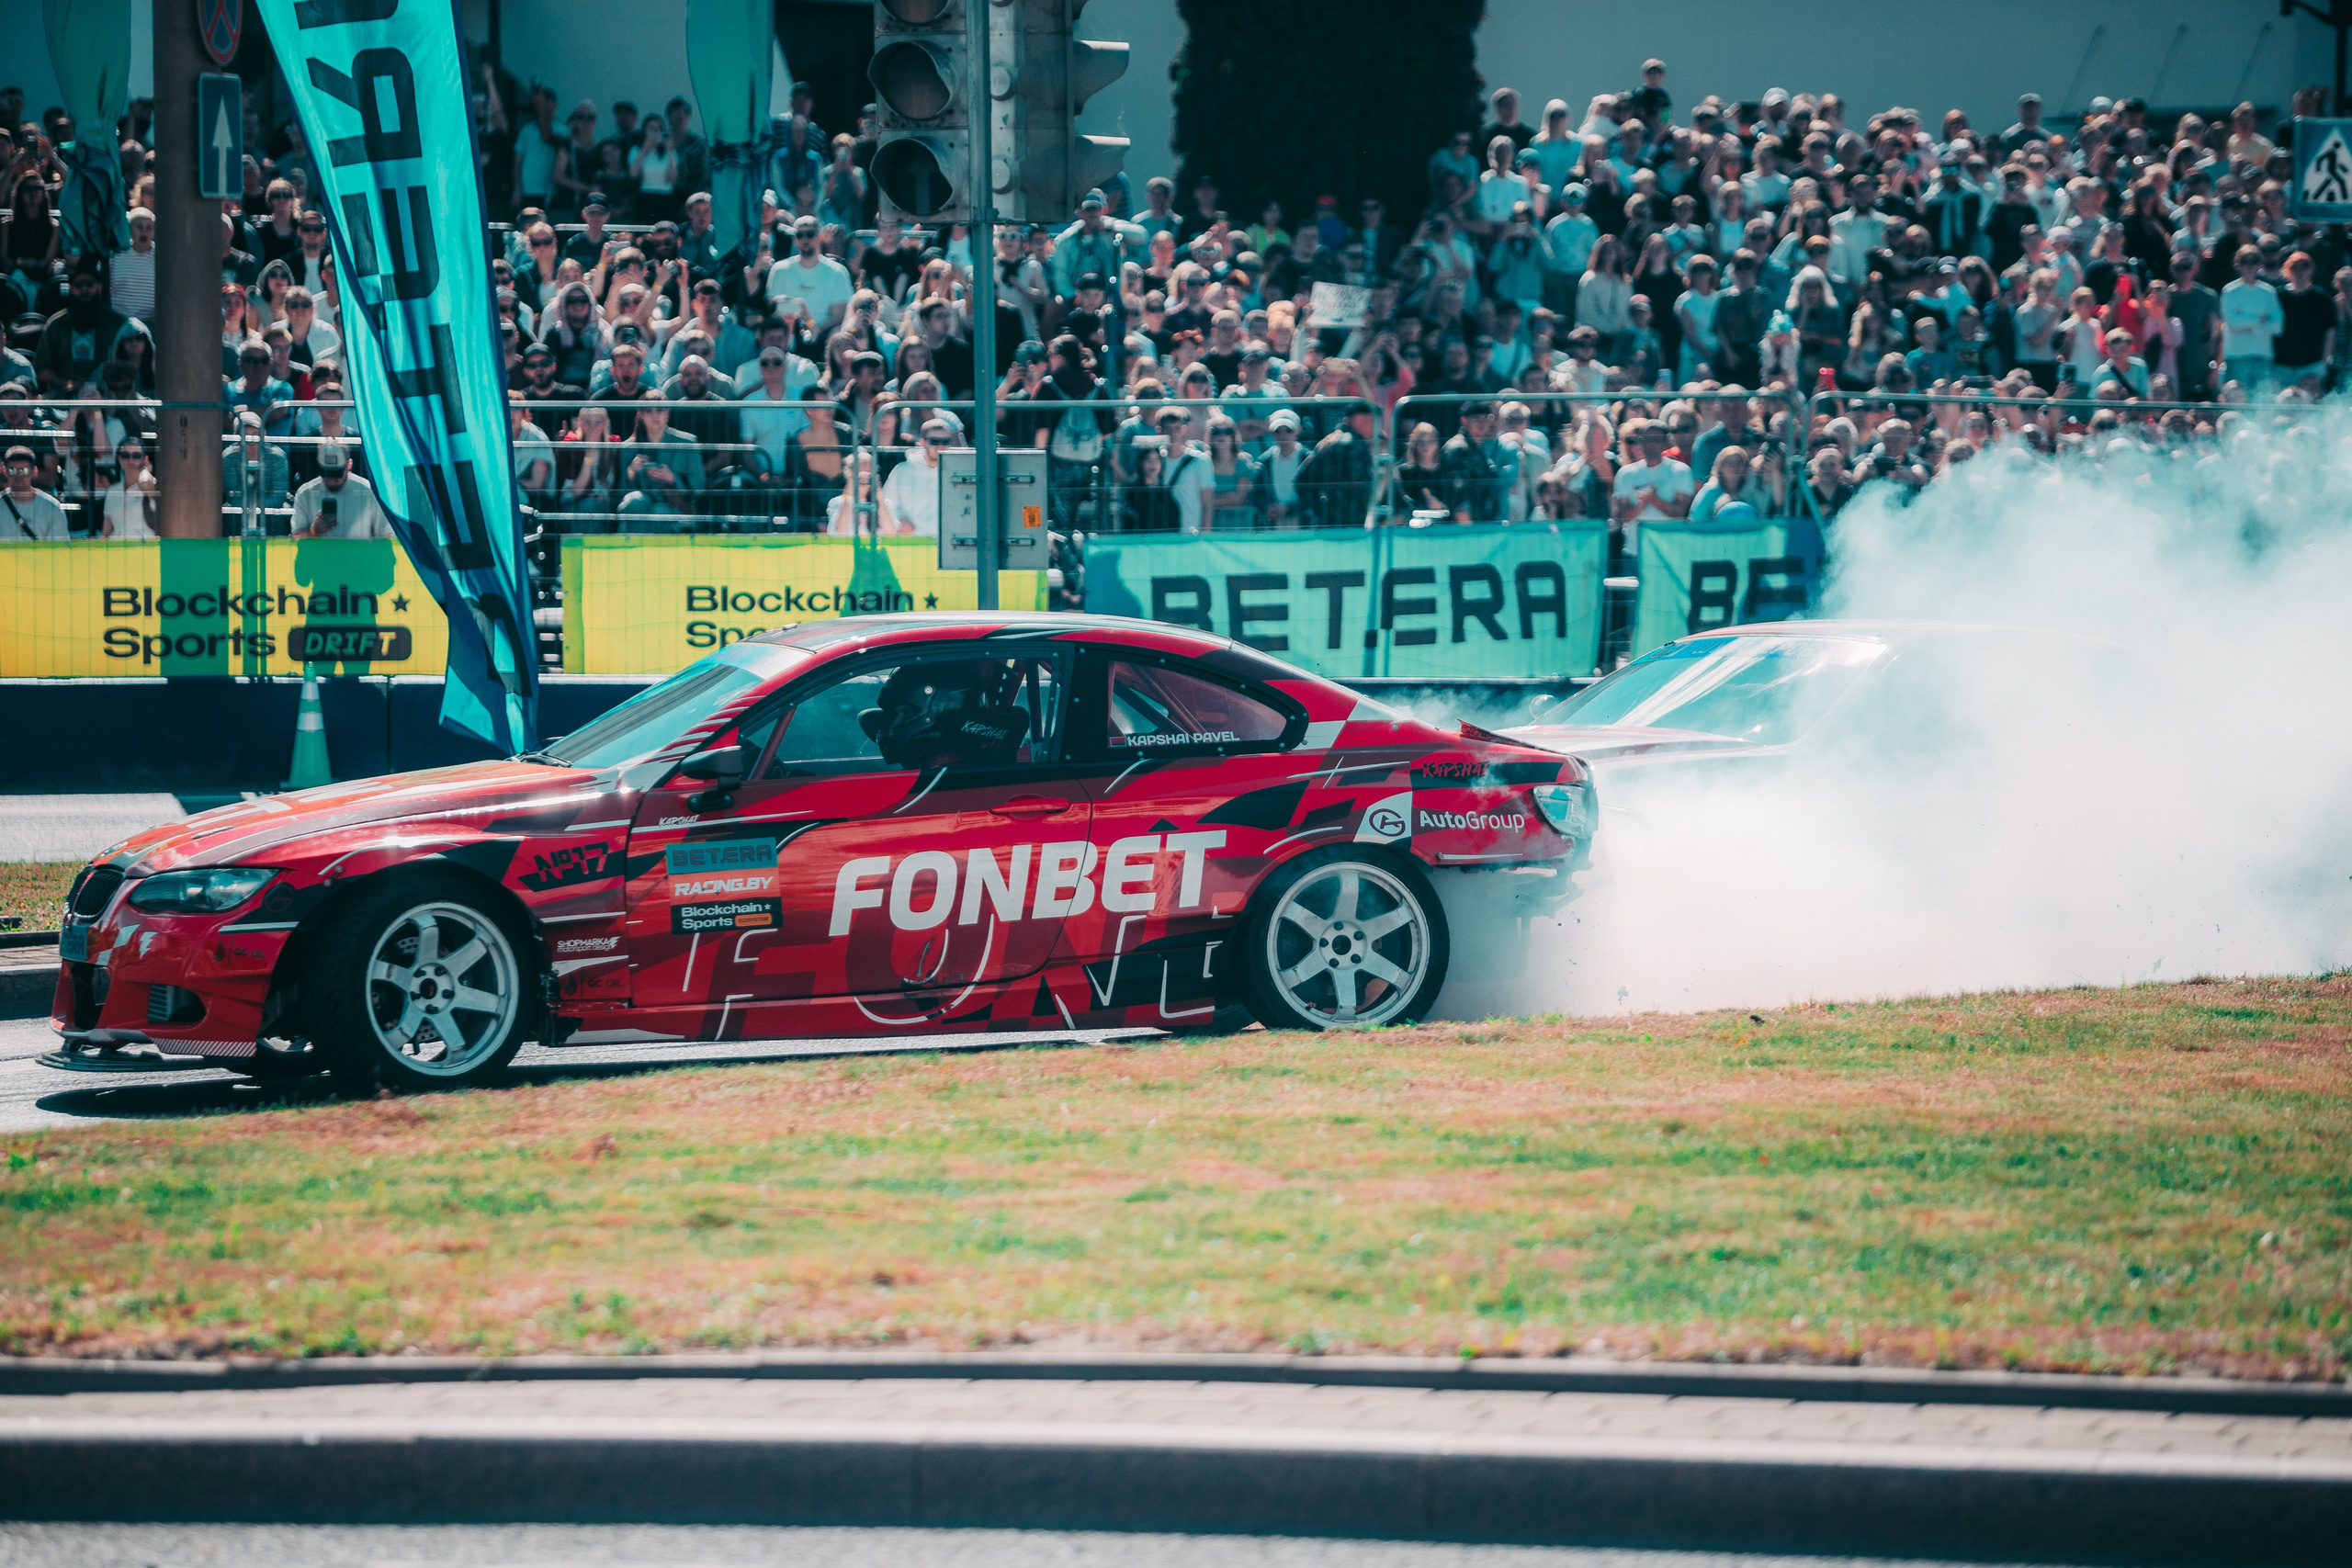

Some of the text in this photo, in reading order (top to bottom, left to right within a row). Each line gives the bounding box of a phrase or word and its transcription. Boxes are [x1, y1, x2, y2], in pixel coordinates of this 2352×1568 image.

[102, 585, 379, 617] Blockchain
[685, 584, 915, 613] Blockchain
[103, 626, 396, 665] Sports DRIFT
[1127, 731, 1240, 746] KAPSHAI PAVEL
[1419, 810, 1525, 833] AutoGroup
[674, 876, 775, 897] RACING.BY
[829, 829, 1227, 937] FONBET
[681, 903, 763, 918] Blockchain
[682, 917, 733, 931] Sports
[557, 938, 610, 949] SHOPMARKA
